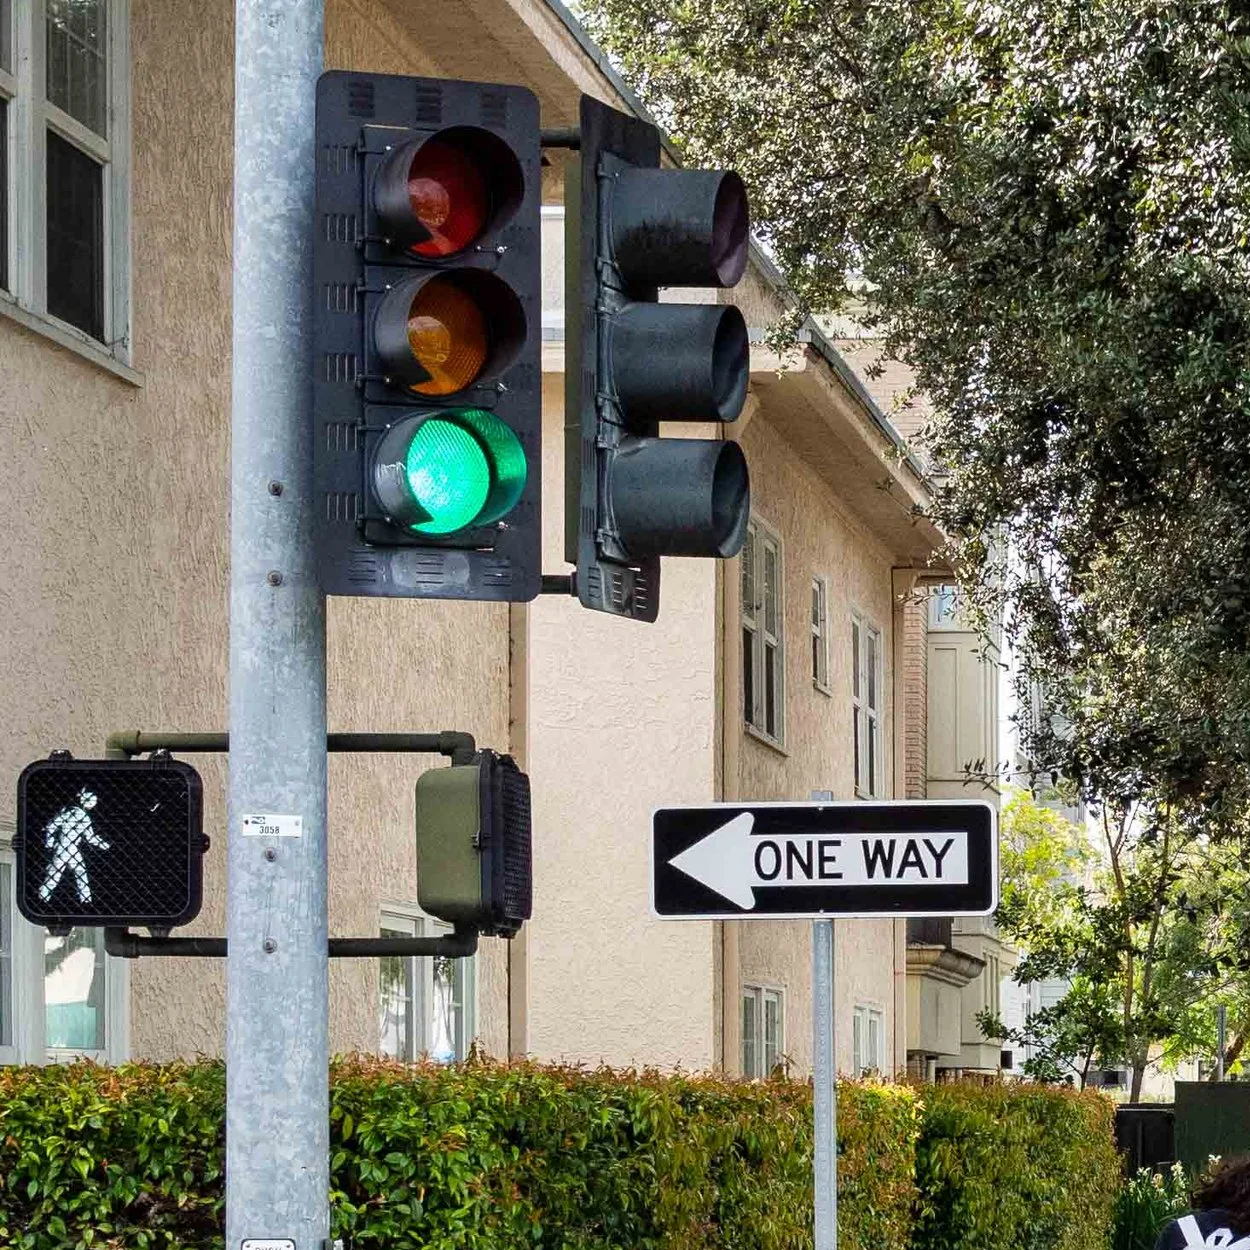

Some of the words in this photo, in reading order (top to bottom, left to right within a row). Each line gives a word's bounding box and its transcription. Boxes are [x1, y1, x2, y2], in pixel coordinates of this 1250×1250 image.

[259, 826, 280, 834] 3058
[754, 840, 843, 881] ONE
[862, 838, 955, 879] WAY
